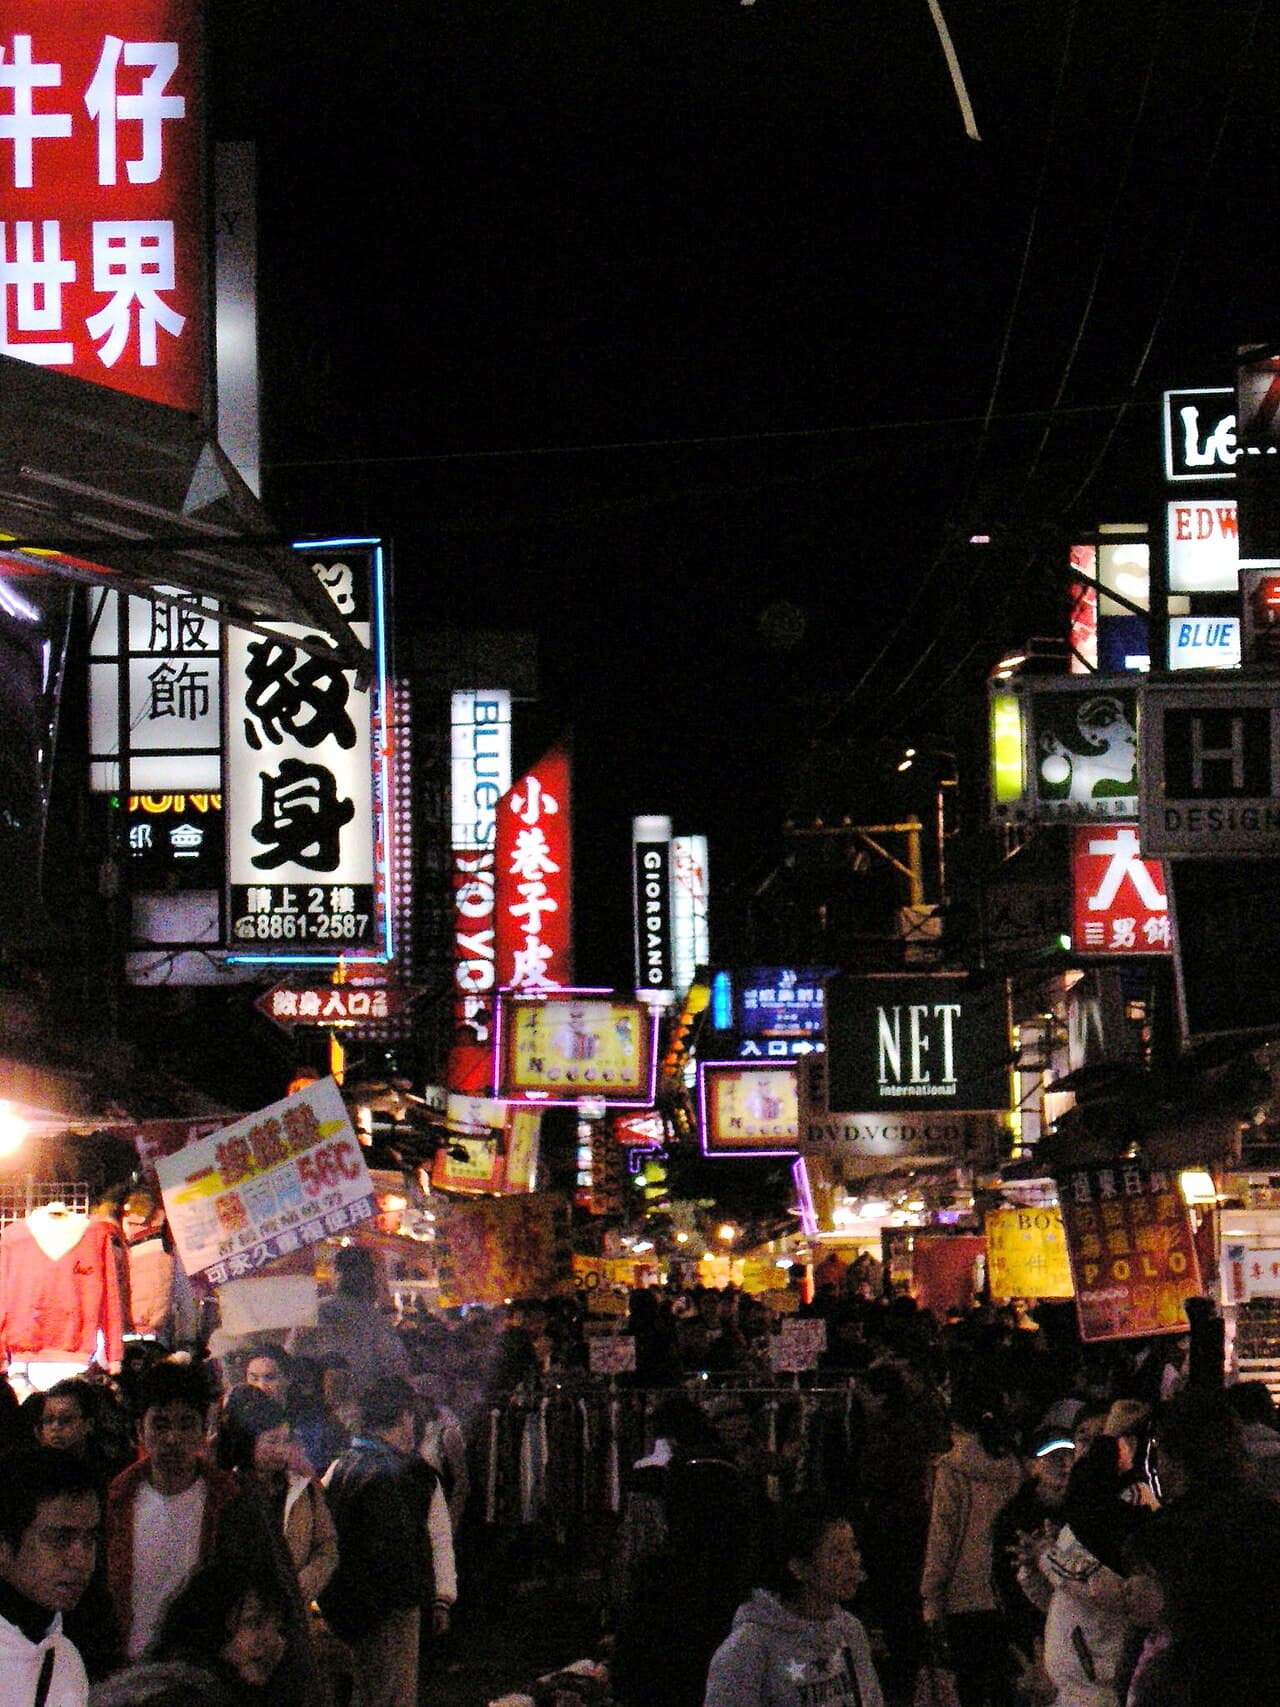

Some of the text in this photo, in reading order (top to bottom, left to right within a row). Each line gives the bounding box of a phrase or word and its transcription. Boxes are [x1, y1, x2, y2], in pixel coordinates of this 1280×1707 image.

[0, 34, 185, 188] 牛仔
[0, 220, 186, 368] 世界
[148, 594, 209, 721] 服飾
[1178, 624, 1233, 647] BLUE
[244, 635, 357, 872] 紋身
[1192, 717, 1244, 788] H
[509, 776, 562, 1000] 小巷子皮
[643, 851, 662, 984] GIORDANO
[741, 1040, 787, 1056] 入口
[877, 1005, 961, 1083] NET
[1083, 1252, 1187, 1285] POLO
